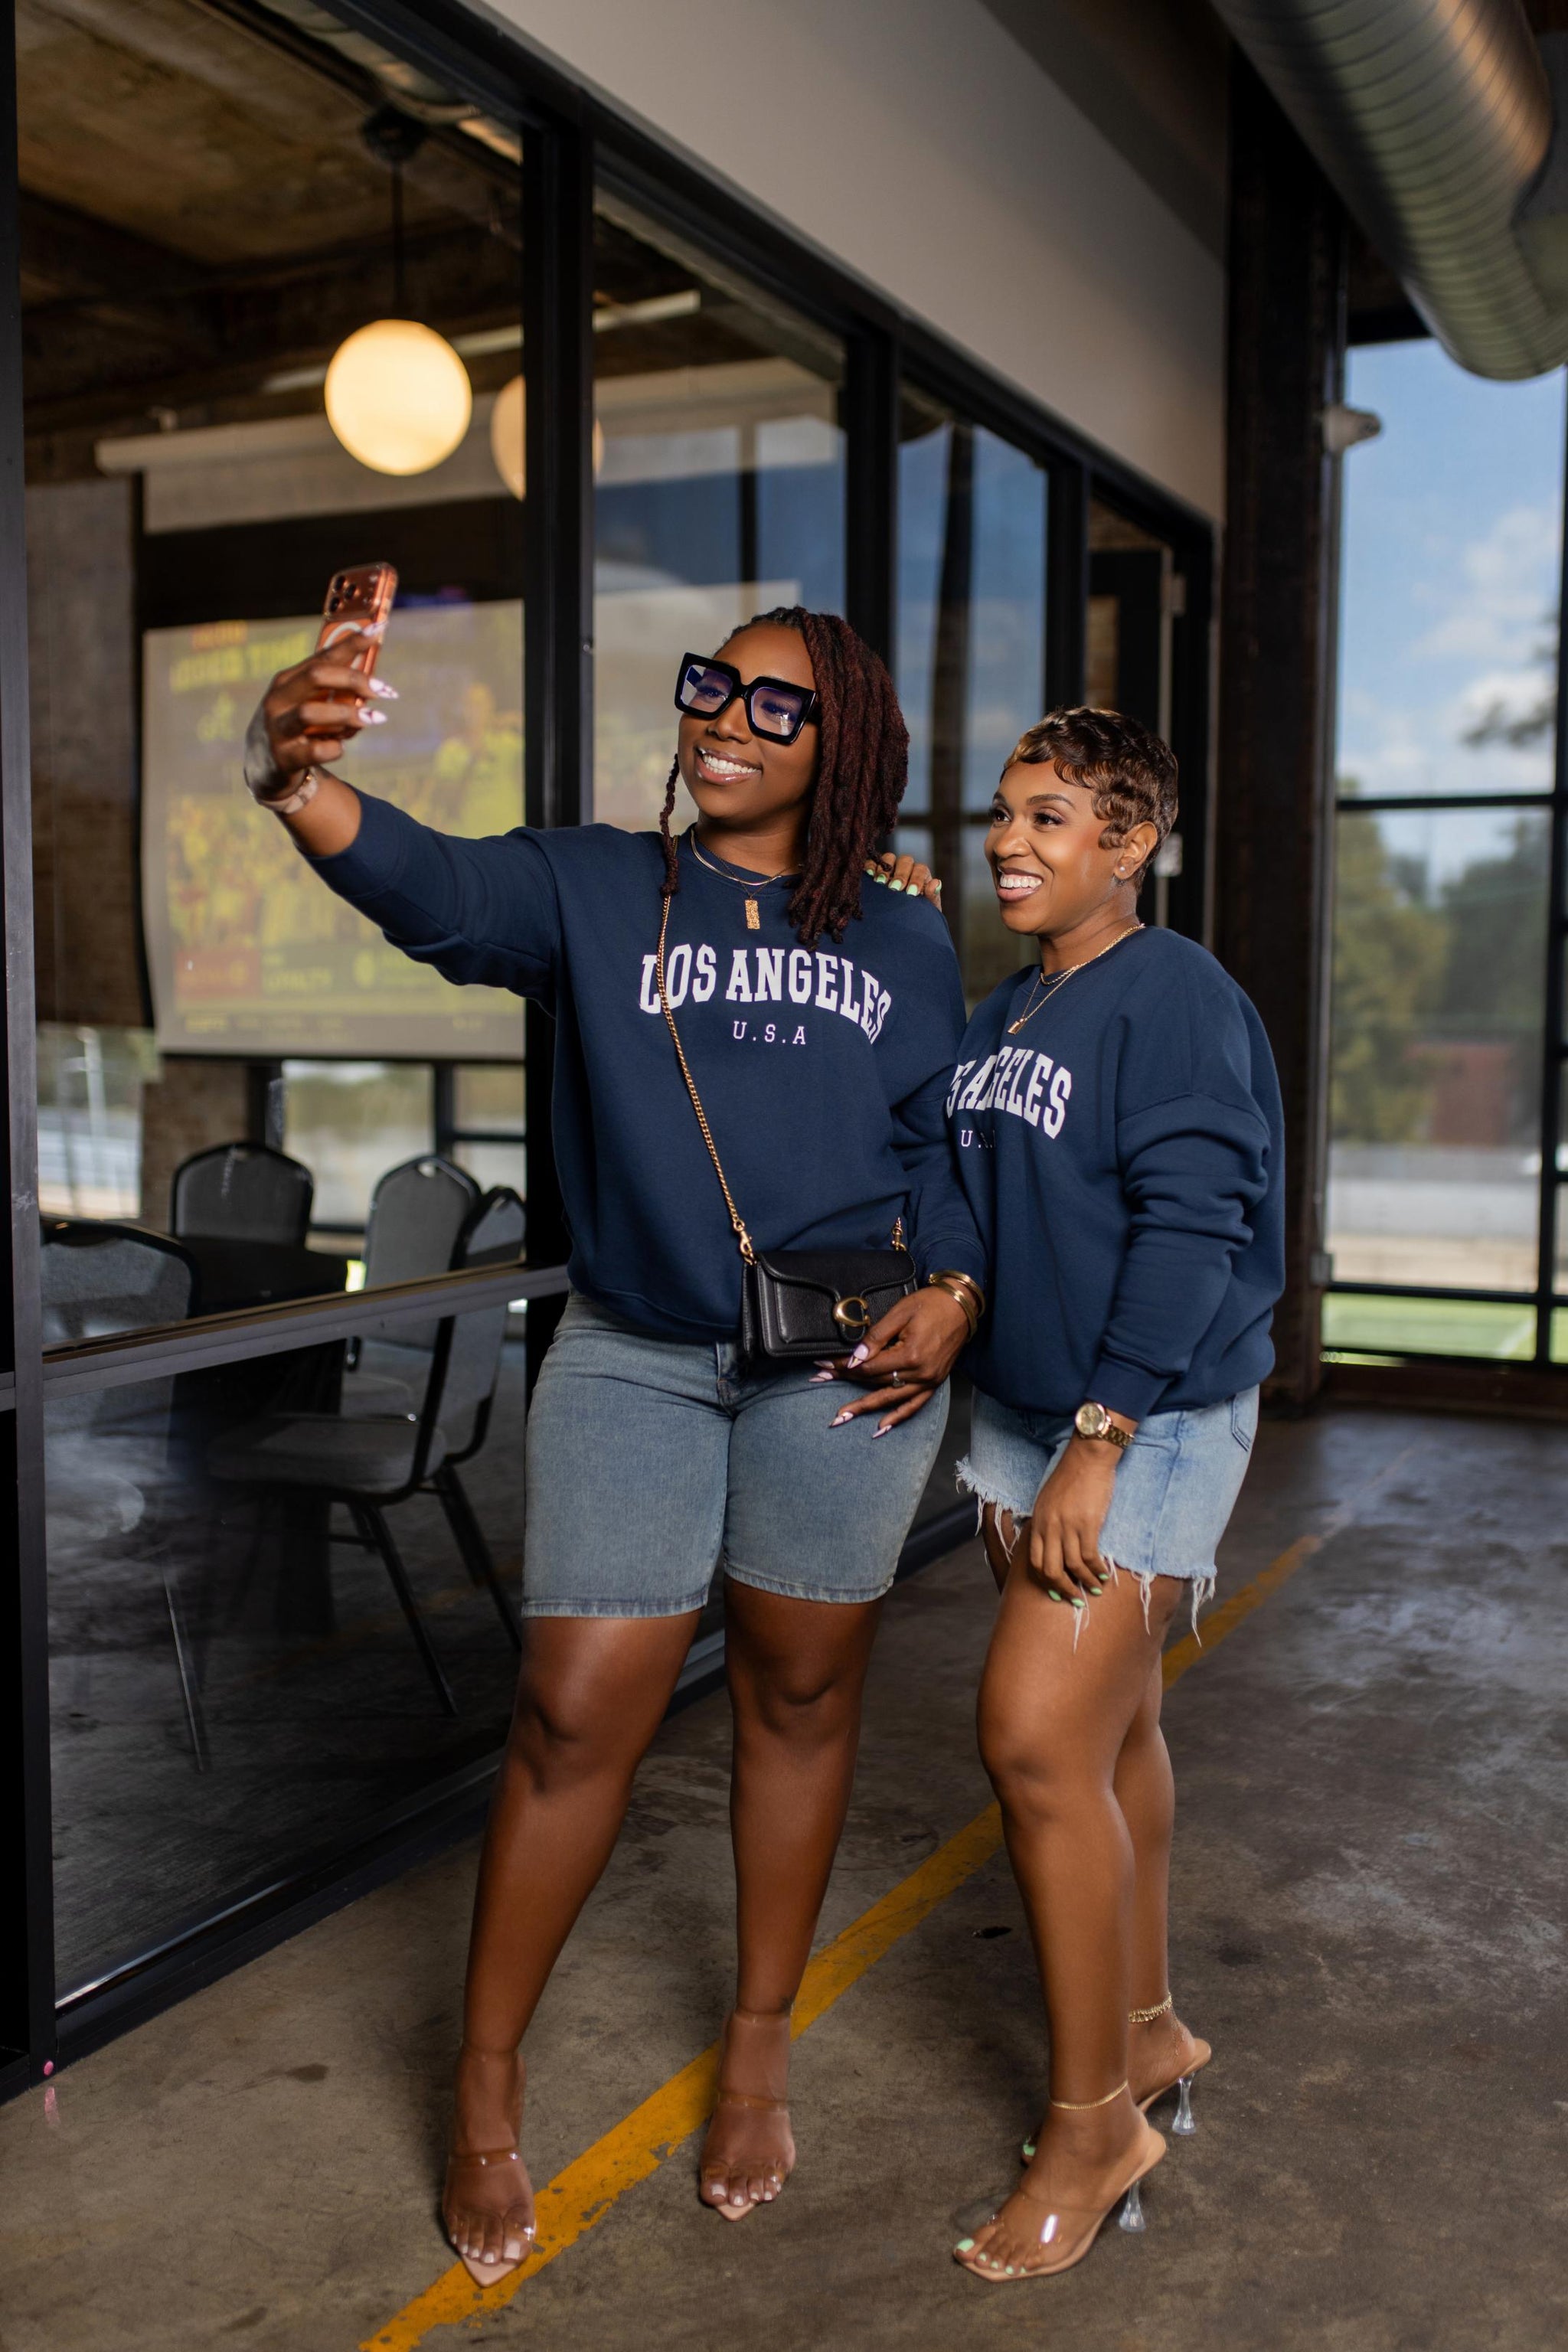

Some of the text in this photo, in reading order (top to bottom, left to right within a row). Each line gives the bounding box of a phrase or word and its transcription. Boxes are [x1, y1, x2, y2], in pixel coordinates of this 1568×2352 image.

[639, 943, 891, 1045] LOS ANGELES
[733, 1021, 806, 1045] U.S.A
